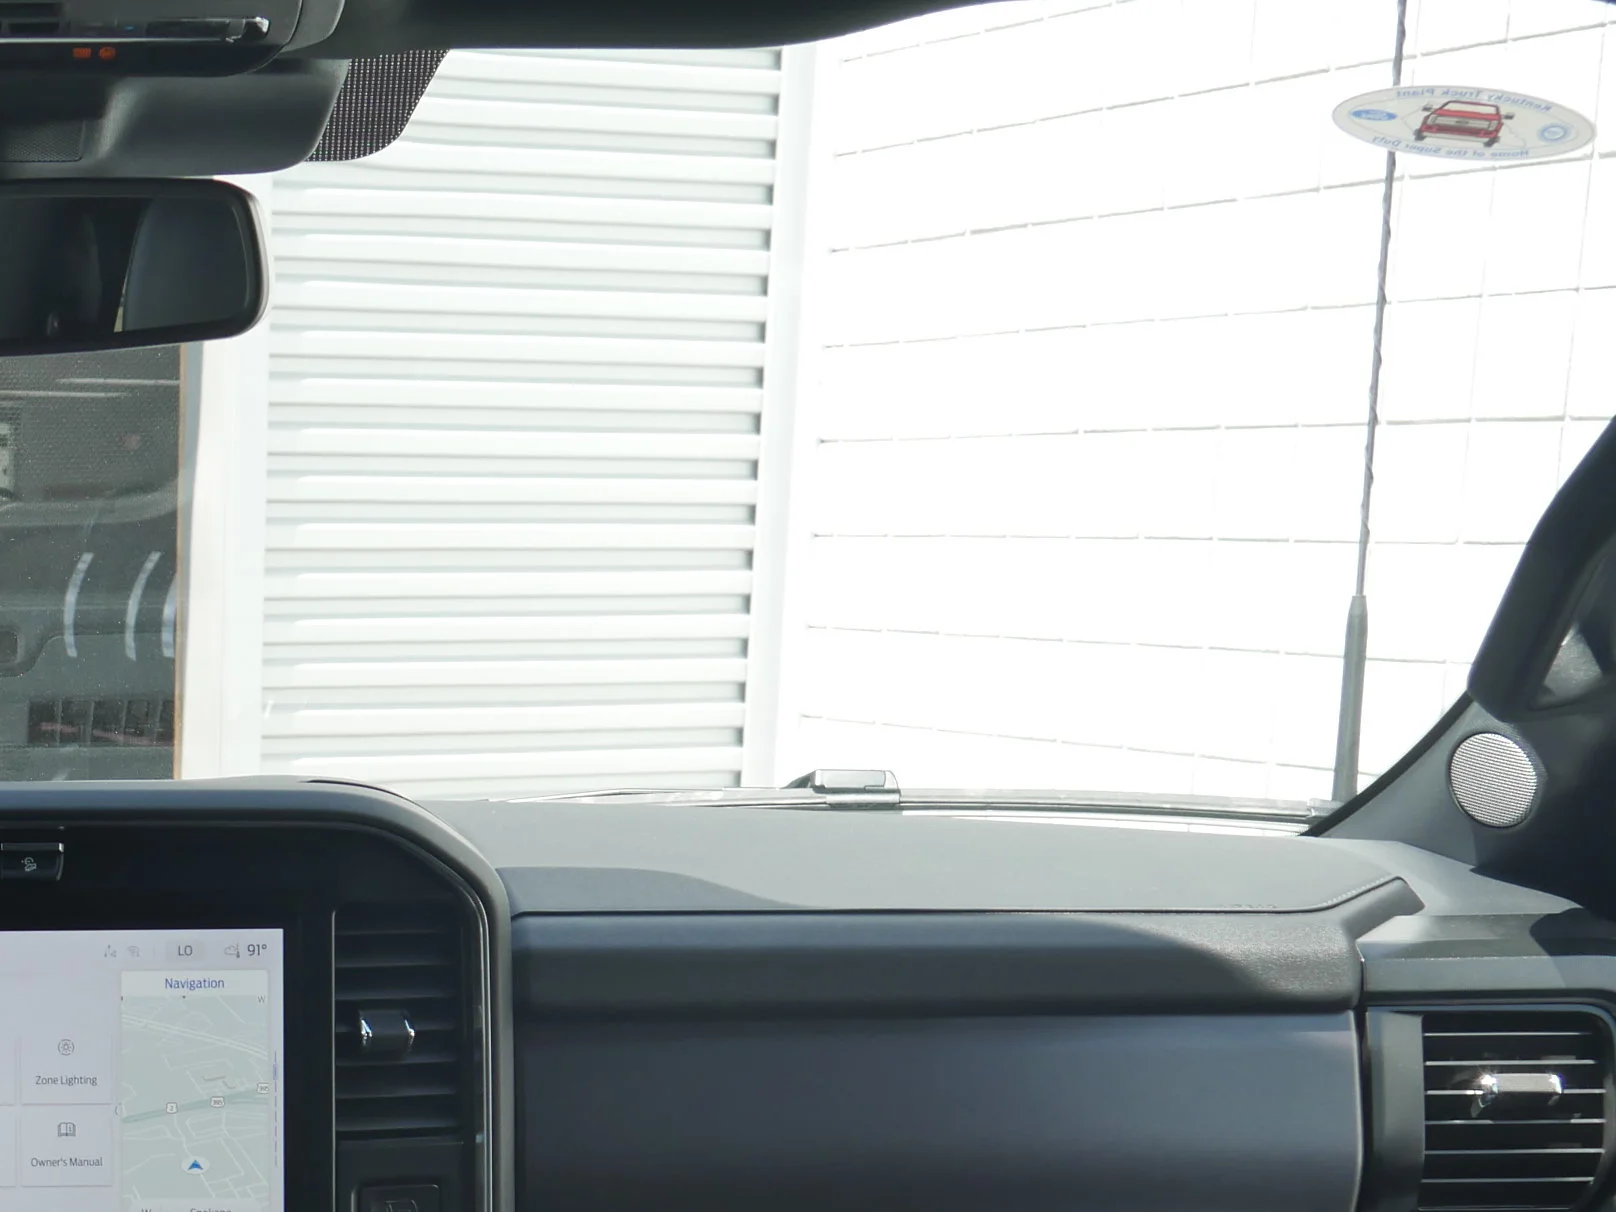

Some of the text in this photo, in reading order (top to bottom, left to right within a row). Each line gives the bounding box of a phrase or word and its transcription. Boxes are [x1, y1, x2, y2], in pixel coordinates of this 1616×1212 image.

[178, 945, 193, 956] LO
[165, 978, 225, 991] Navigation
[35, 1075, 98, 1087] Zone Lighting
[31, 1157, 103, 1168] Owner's Manual
